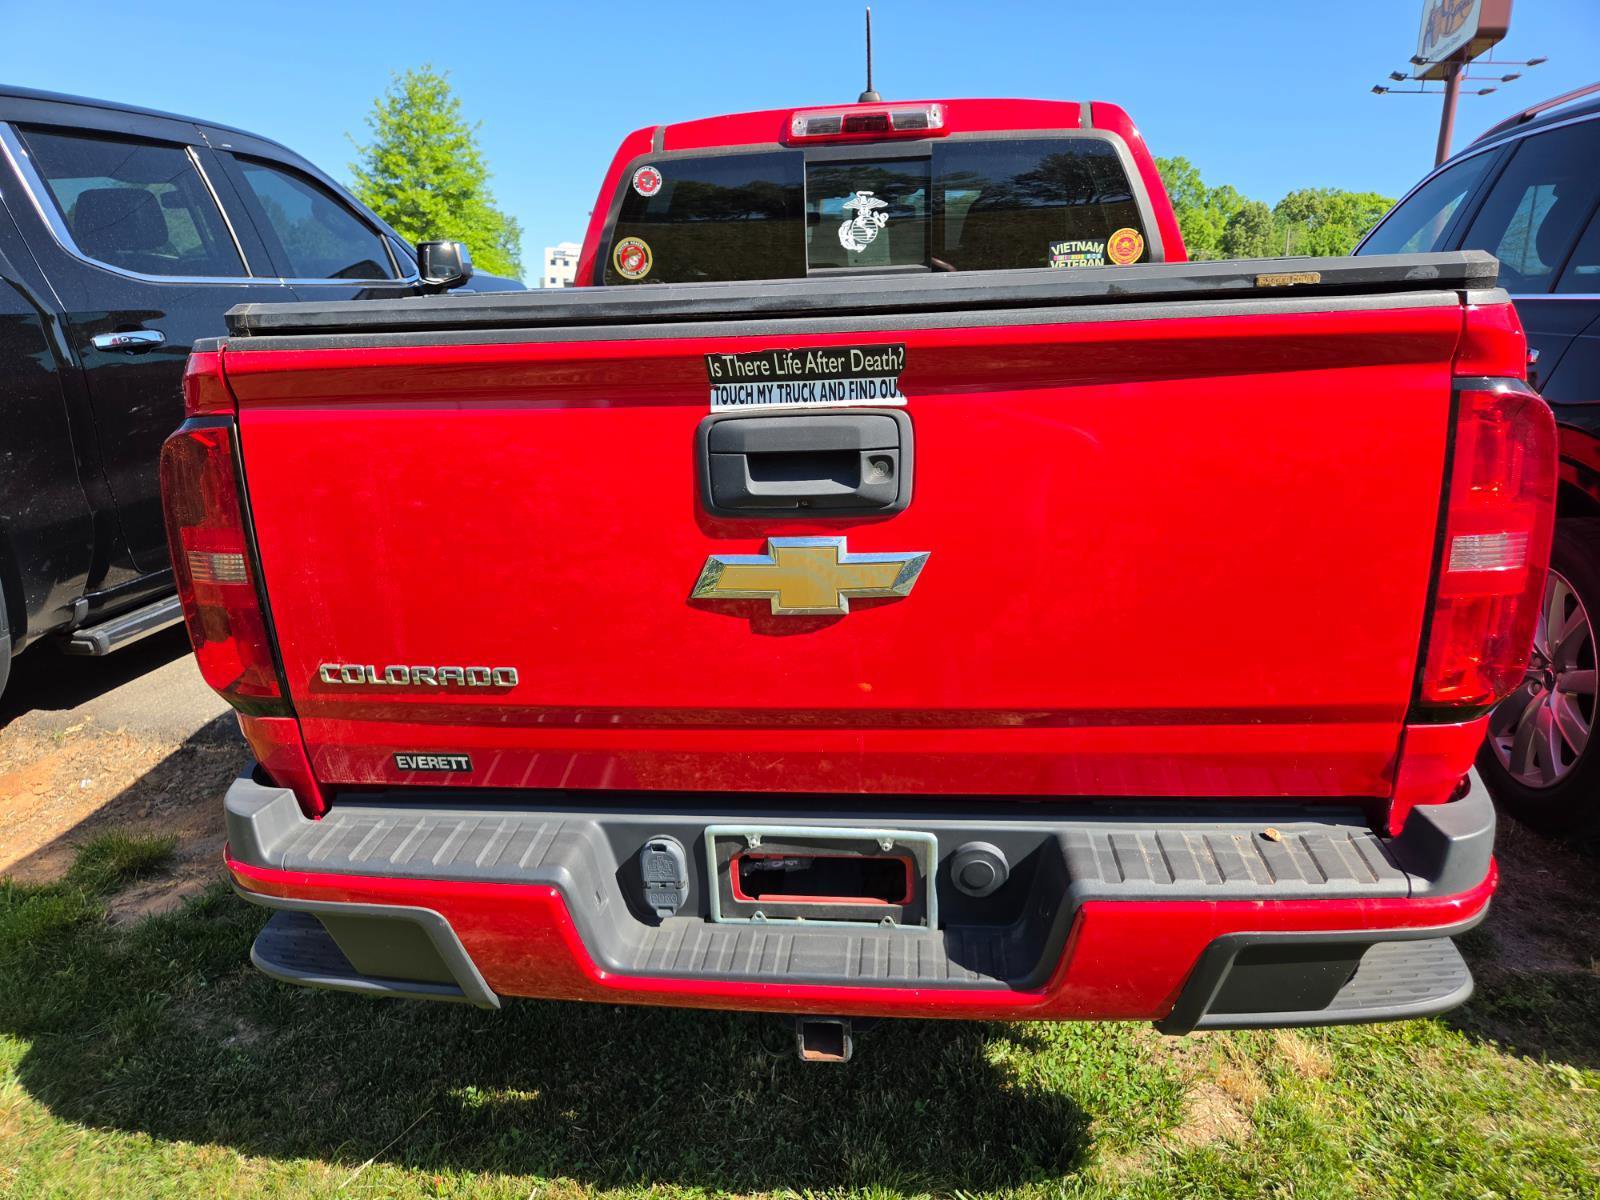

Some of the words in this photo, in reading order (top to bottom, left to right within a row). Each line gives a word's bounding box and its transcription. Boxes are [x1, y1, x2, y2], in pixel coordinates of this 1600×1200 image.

[1051, 241, 1104, 255] VIETNAM
[1050, 258, 1104, 268] VETERAN
[708, 356, 722, 377] Is
[722, 355, 770, 376] There
[773, 352, 801, 375] Life
[805, 350, 845, 373] After
[850, 347, 904, 372] Death?
[714, 384, 753, 405] TOUCH
[757, 383, 773, 403] MY
[777, 381, 815, 403] TRUCK
[820, 380, 846, 401] AND
[849, 377, 876, 398] FIND
[879, 377, 903, 398] OU
[319, 663, 519, 687] COLORADO
[395, 755, 469, 770] EVERETT
